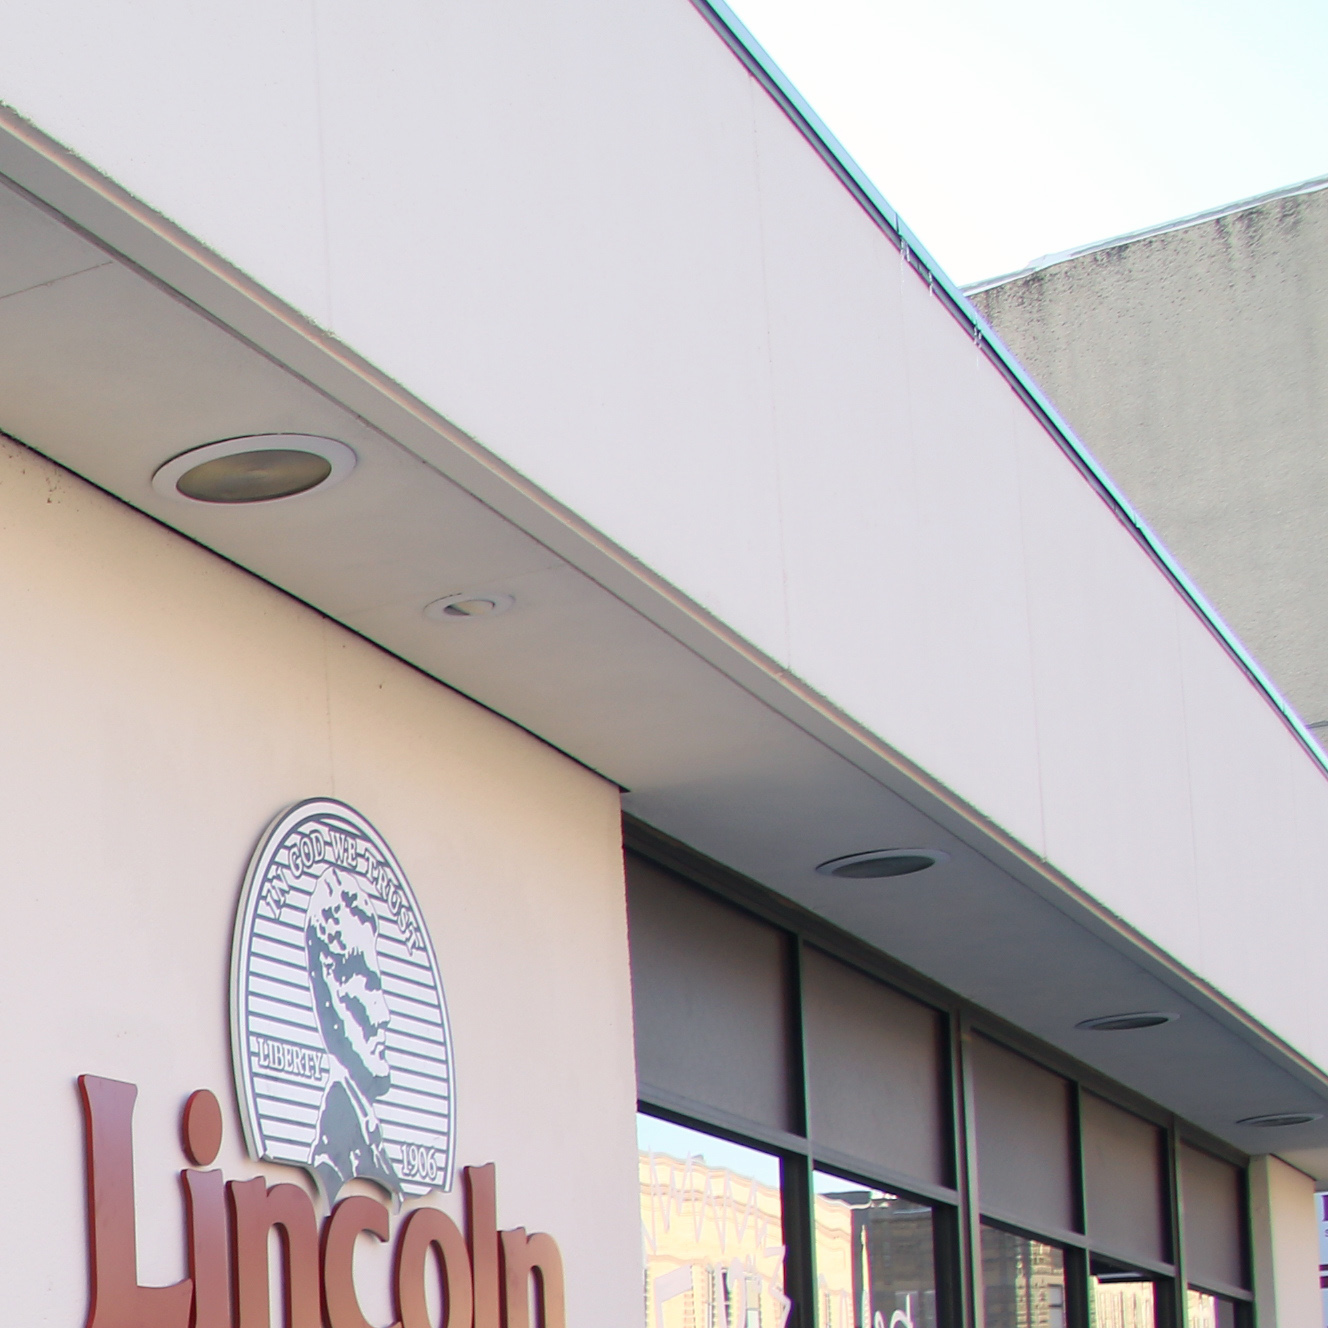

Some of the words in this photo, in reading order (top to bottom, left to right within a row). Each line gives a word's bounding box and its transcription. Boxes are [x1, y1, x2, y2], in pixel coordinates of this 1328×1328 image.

[263, 864, 291, 920] IN
[287, 828, 325, 871] GOD
[329, 825, 358, 867] WE
[363, 847, 423, 958] TRUST
[256, 1035, 325, 1081] LIBERTY
[399, 1143, 439, 1181] 1906
